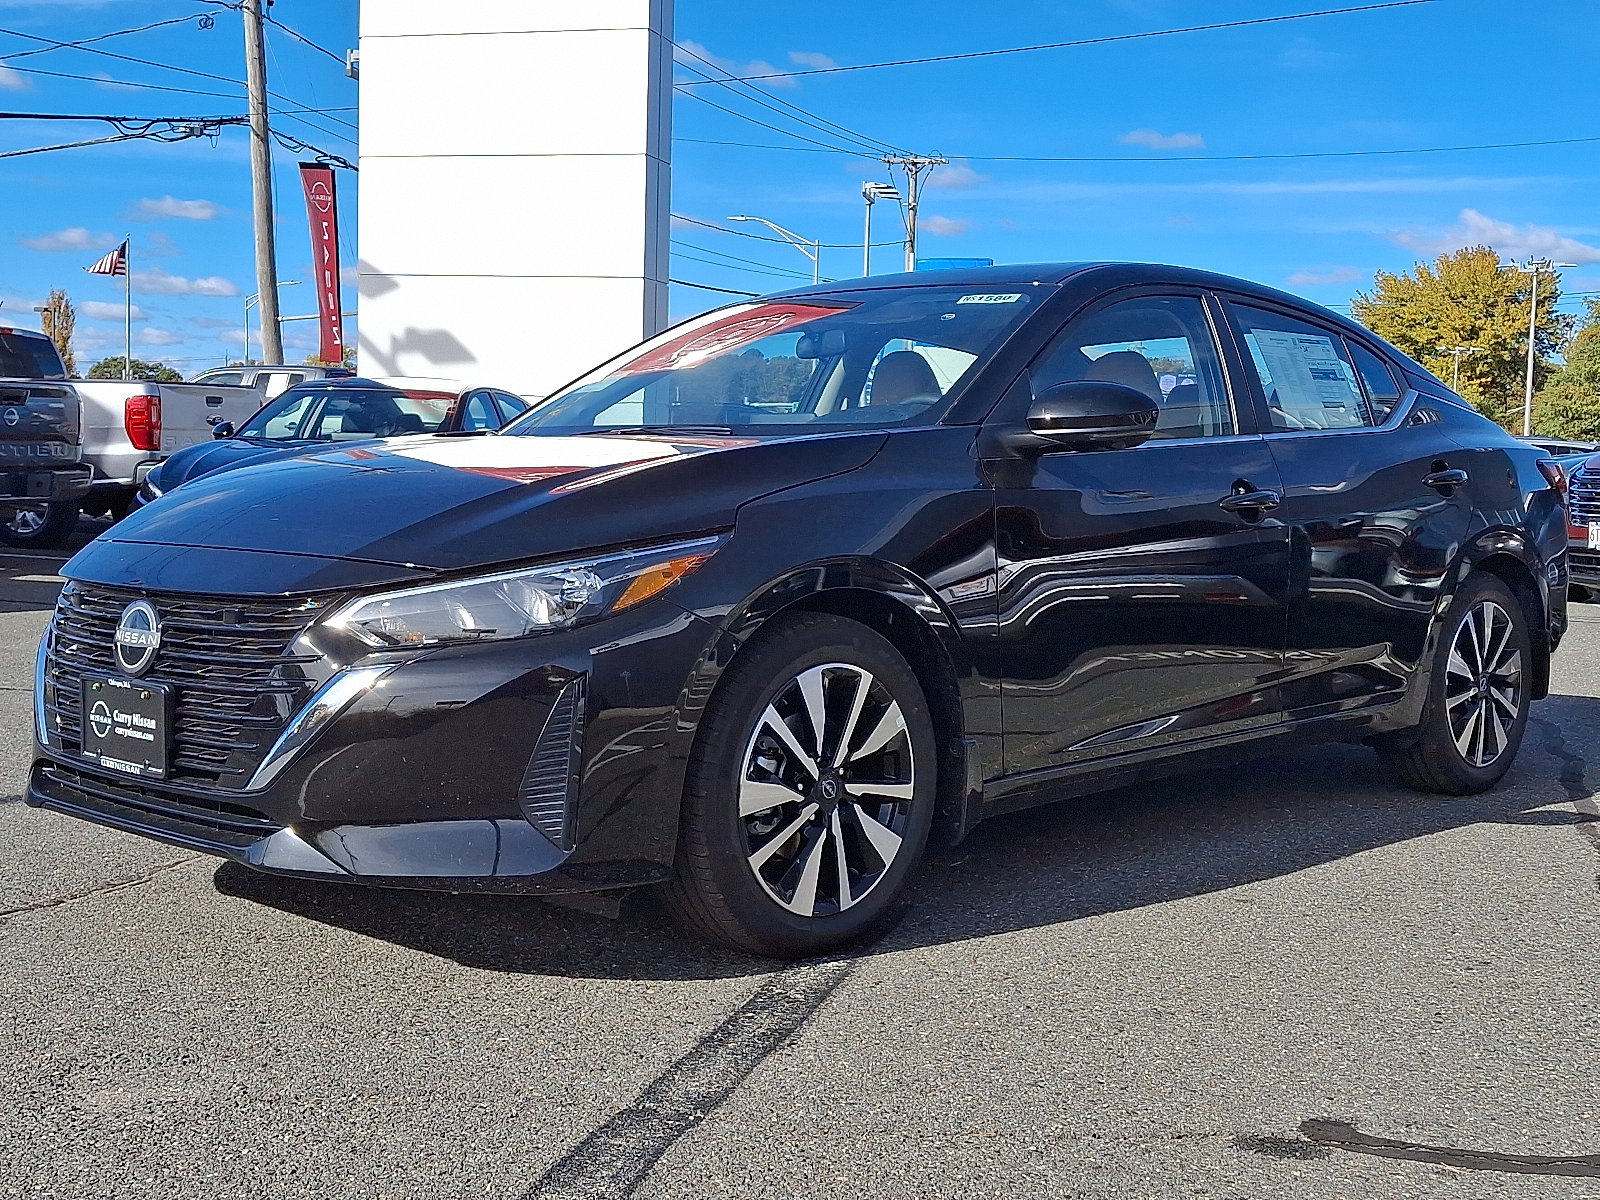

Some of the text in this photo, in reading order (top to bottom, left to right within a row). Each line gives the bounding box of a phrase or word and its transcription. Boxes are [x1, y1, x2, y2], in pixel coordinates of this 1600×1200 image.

[115, 629, 158, 647] NISSAN
[89, 713, 112, 725] NISSAN
[113, 710, 156, 729] Curry Nissan
[115, 727, 154, 741] currynissan.com
